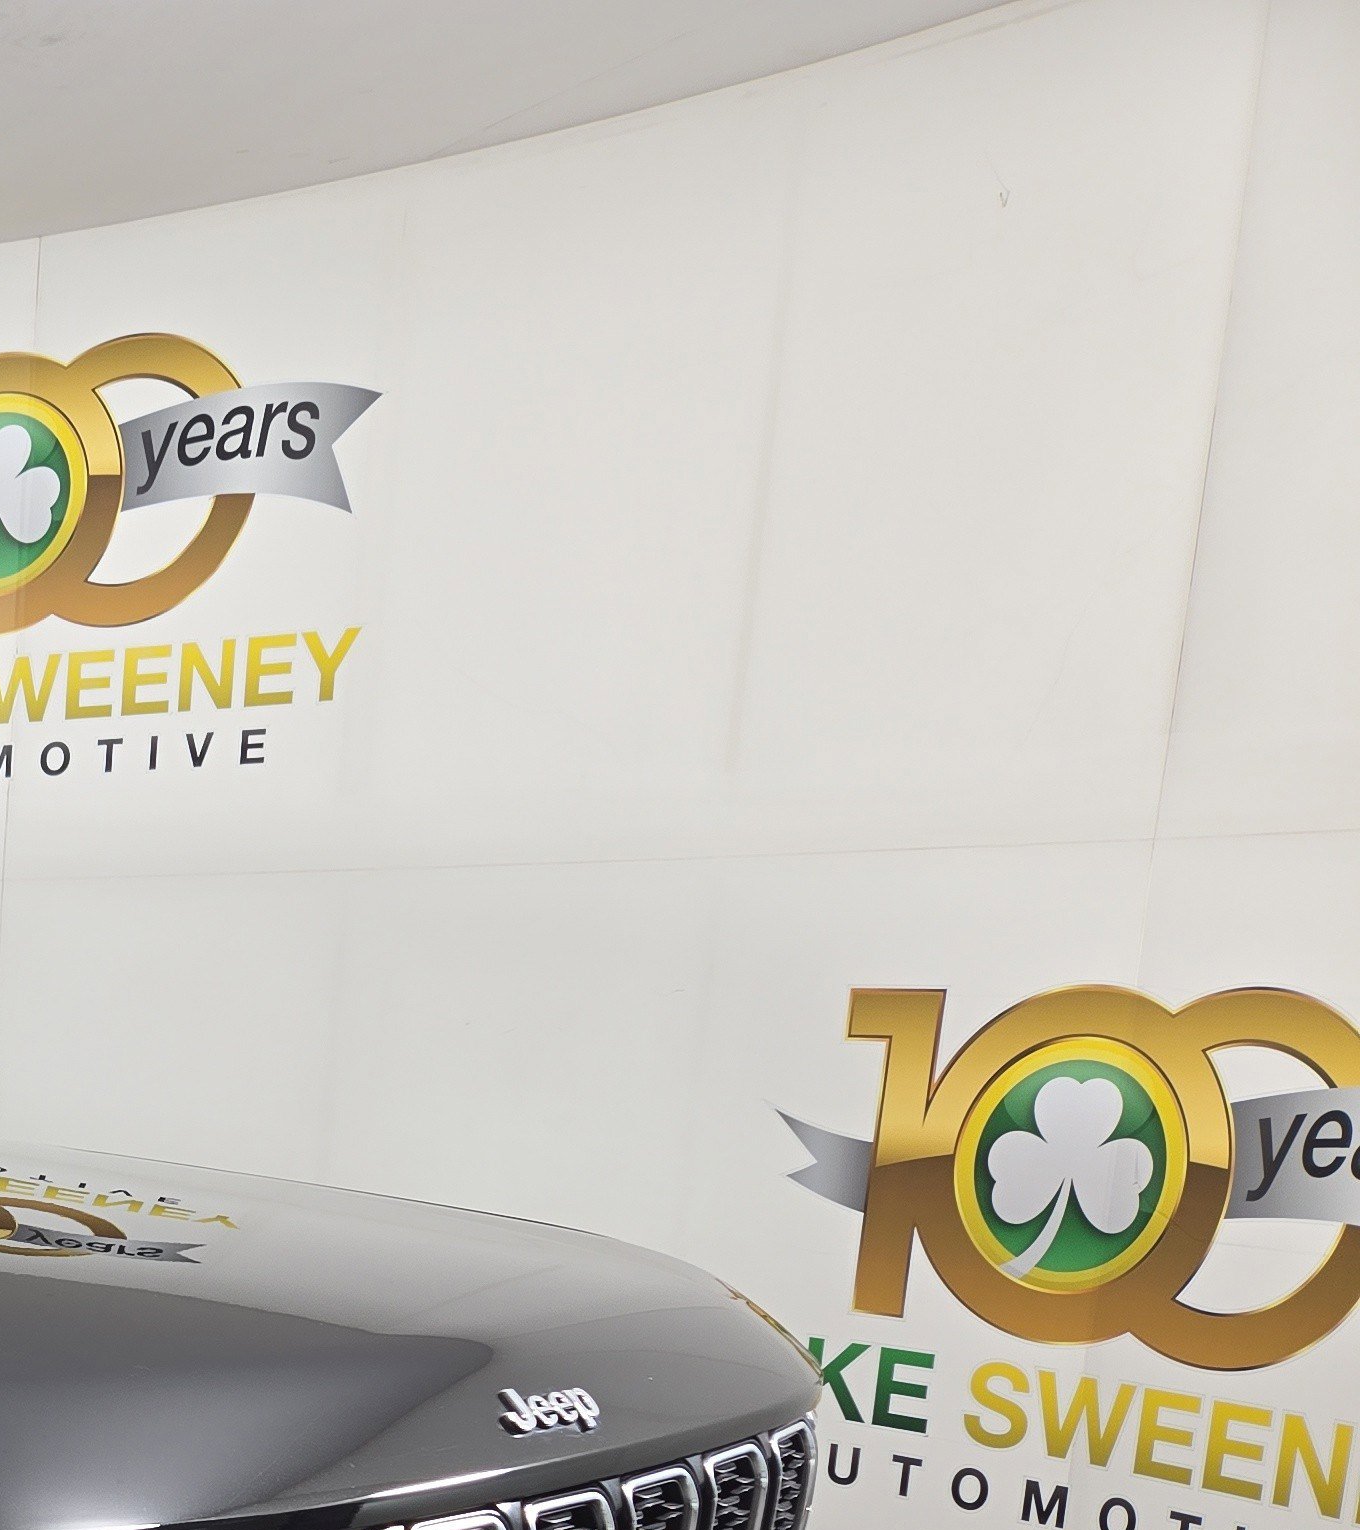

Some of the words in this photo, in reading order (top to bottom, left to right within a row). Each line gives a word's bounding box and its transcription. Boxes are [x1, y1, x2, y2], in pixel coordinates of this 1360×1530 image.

[136, 401, 321, 496] years
[1245, 1104, 1360, 1203] ye
[497, 1387, 600, 1437] Jeep
[962, 1360, 1360, 1530] SWEEN
